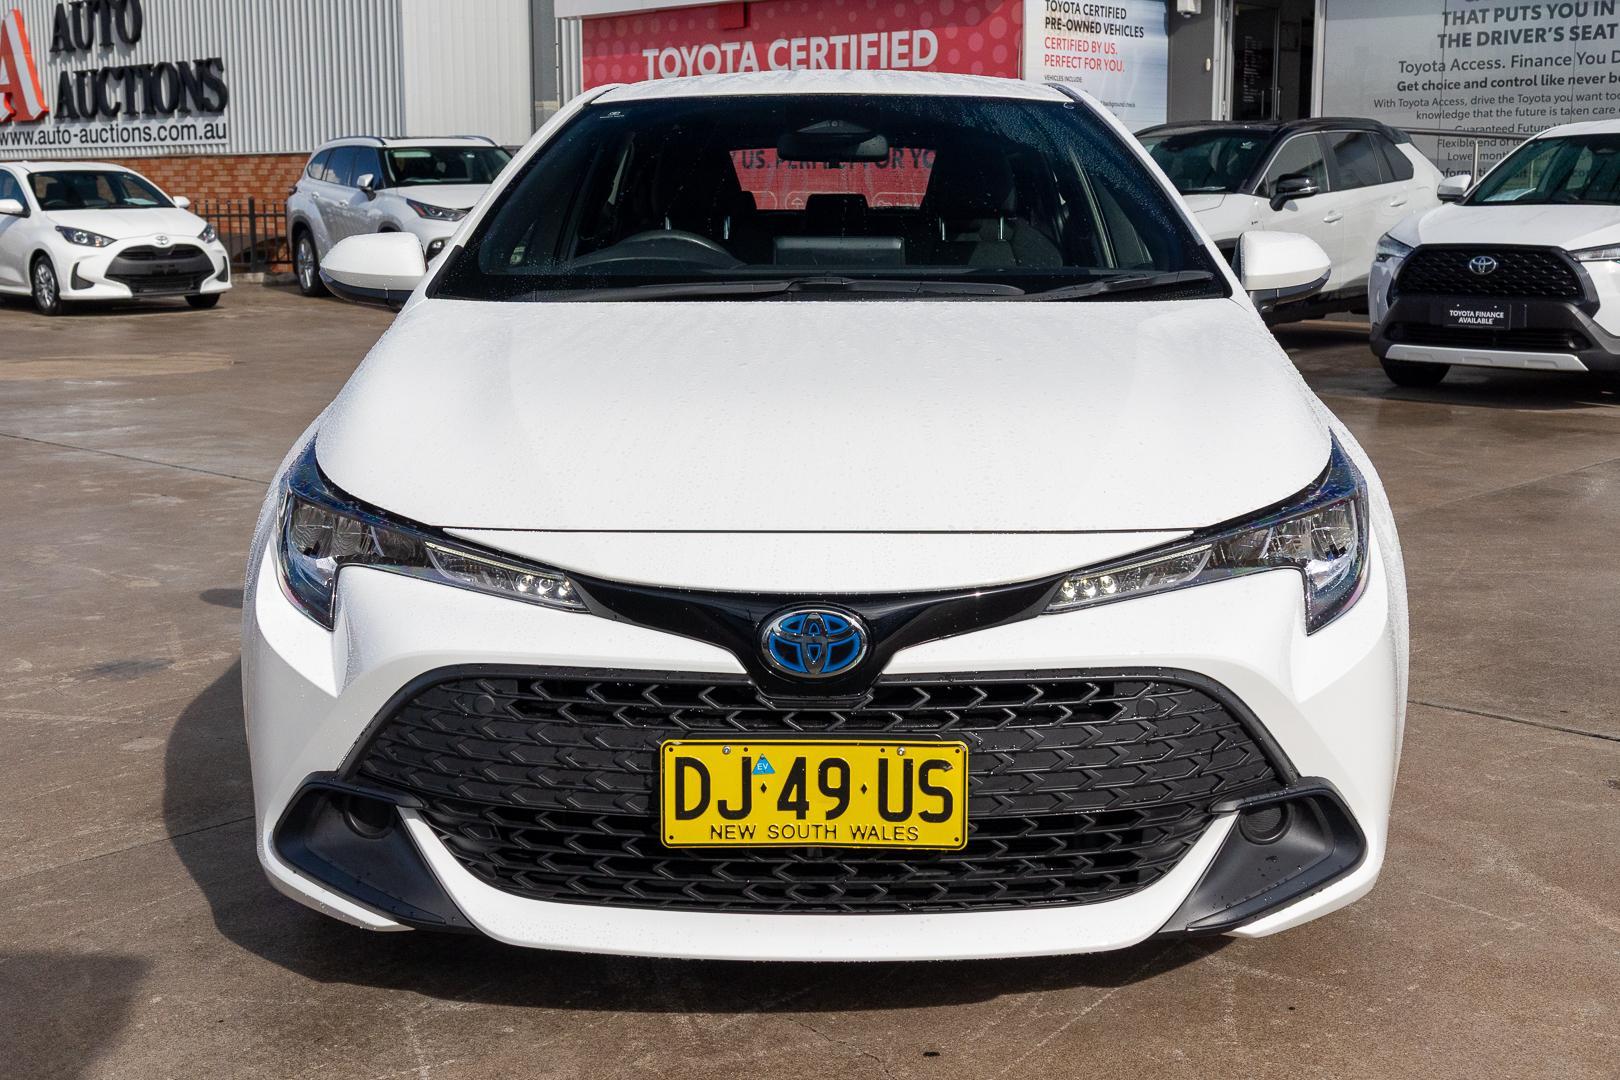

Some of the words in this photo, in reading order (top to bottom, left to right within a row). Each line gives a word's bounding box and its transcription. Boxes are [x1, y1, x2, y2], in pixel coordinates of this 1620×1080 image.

[1045, 0, 1081, 15] TOYOTA
[1083, 3, 1127, 20] CERTIFIED
[1442, 8, 1490, 26] THAT
[1493, 5, 1542, 23] PUTS
[1546, 2, 1588, 19] YOU
[1593, 0, 1616, 17] IN
[50, 0, 142, 53] AUTO
[1045, 17, 1102, 34] PRE-OWNED
[1103, 23, 1145, 38] VEHICLES
[1437, 32, 1472, 48] THE
[1476, 27, 1565, 46] DRIVER'S
[1569, 23, 1619, 41] SEAT
[642, 41, 760, 81] TOYOTA
[767, 29, 939, 72] CERTIFIED
[1044, 36, 1090, 52] CERTIFIED
[1092, 41, 1102, 53] BY
[1104, 42, 1118, 55] US.
[1044, 55, 1082, 69] PERFECT
[1084, 58, 1102, 70] FOR
[1104, 59, 1125, 73] YOU.
[1398, 60, 1446, 76] Toyota
[1450, 57, 1506, 71] Access.
[1511, 54, 1572, 69] Finance
[1576, 51, 1606, 65] You
[54, 57, 228, 119] AUCTIONS
[1397, 80, 1420, 92] Get
[1421, 79, 1461, 91] choice
[1463, 77, 1488, 89] and
[1490, 74, 1538, 88] control
[1541, 73, 1565, 86] like
[1568, 75, 1606, 86] never
[1373, 98, 1396, 109] With
[1398, 97, 1430, 110] Toyota
[1431, 97, 1468, 107] Access,
[1470, 95, 1496, 105] drive
[1498, 94, 1515, 104] the
[1518, 93, 1552, 106] Toyota
[1554, 94, 1573, 104] you
[1576, 92, 1602, 101] want
[1416, 109, 1471, 120] knowledge
[1473, 108, 1494, 118] that
[1496, 107, 1513, 118] the
[1515, 106, 1547, 117] future
[1549, 106, 1558, 116] is
[1561, 105, 1590, 116] taken
[1592, 106, 1616, 115] care
[0, 121, 227, 146] www.auto-auctions.com.au
[1477, 138, 1497, 147] end
[1447, 152, 1473, 161] Lowe
[1449, 309, 1475, 317] TOYOTA
[1475, 311, 1505, 319] FINANCE
[1458, 317, 1493, 325] AVAILABLE
[756, 763, 769, 771] EV
[710, 824, 757, 840] NEW
[768, 824, 837, 840] SOUTH
[850, 825, 919, 841] WALES
